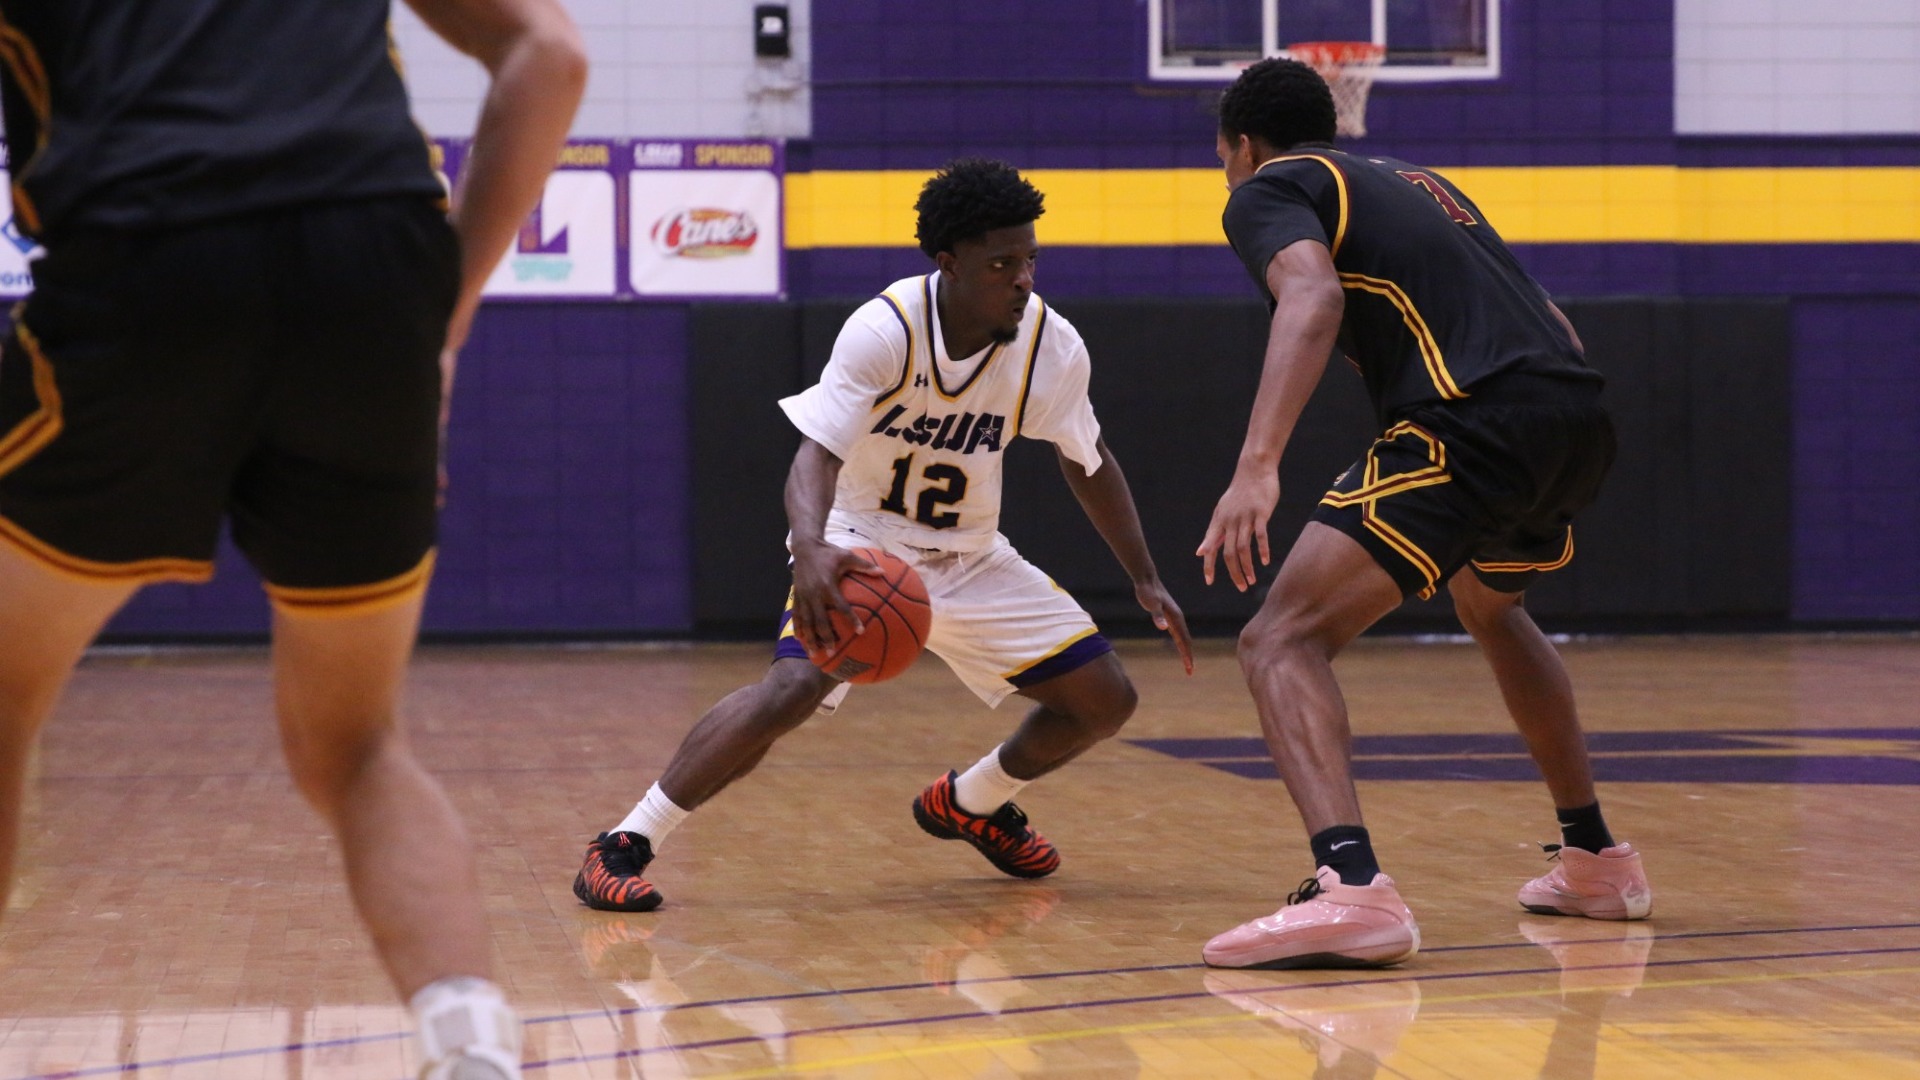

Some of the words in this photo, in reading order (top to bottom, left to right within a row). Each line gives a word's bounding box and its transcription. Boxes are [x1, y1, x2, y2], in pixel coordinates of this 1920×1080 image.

[695, 144, 773, 166] SPONSOR
[870, 404, 1006, 454] LSUA
[879, 452, 968, 530] 12
